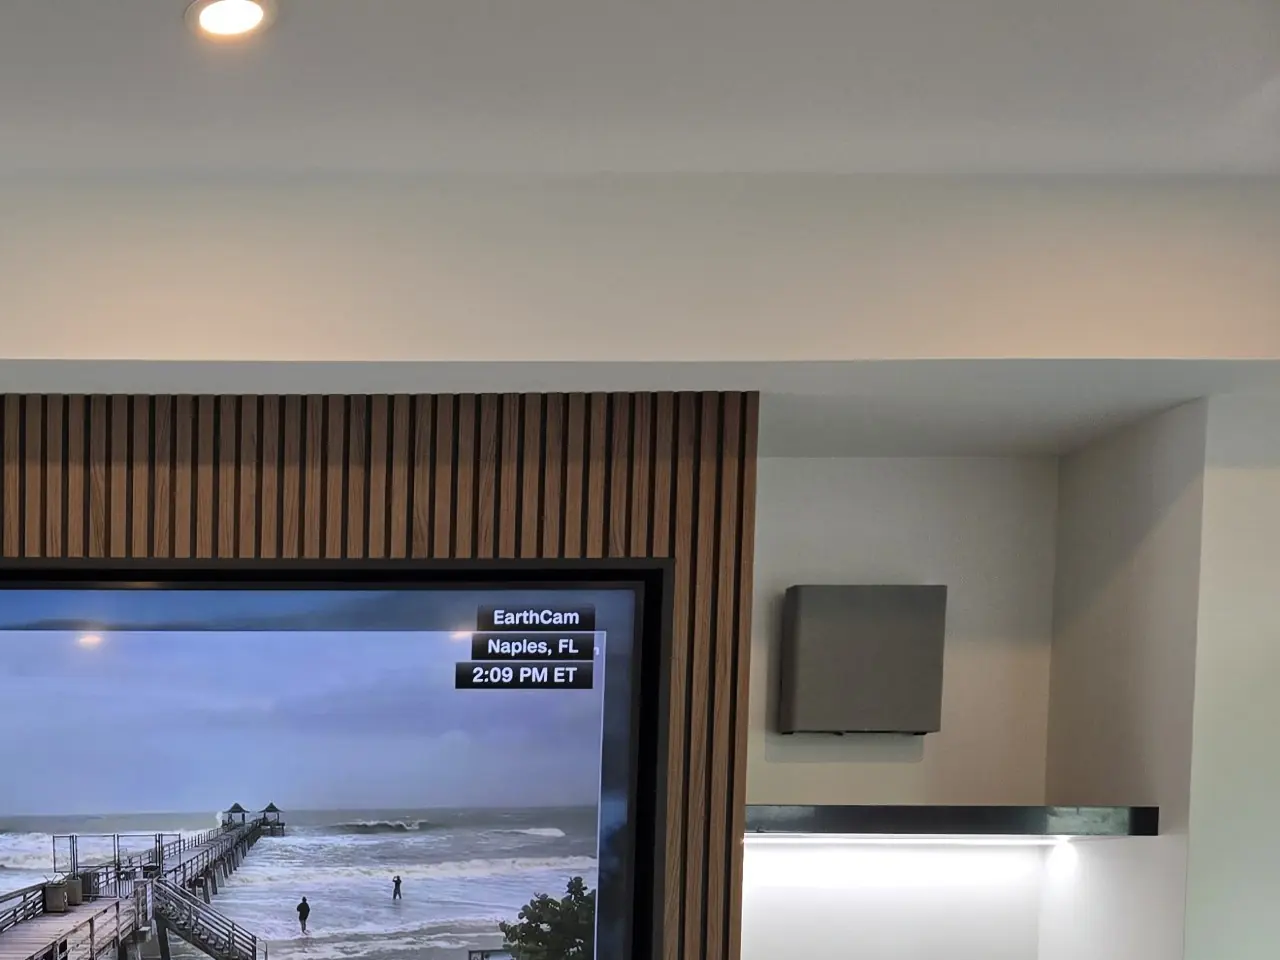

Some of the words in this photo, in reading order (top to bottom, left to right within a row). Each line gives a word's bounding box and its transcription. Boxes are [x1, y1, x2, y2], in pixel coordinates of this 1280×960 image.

[493, 609, 579, 625] EarthCam
[488, 639, 552, 656] Naples,
[558, 640, 579, 653] FL
[472, 667, 513, 683] 2:09
[519, 668, 548, 683] PM
[554, 667, 577, 683] ET
